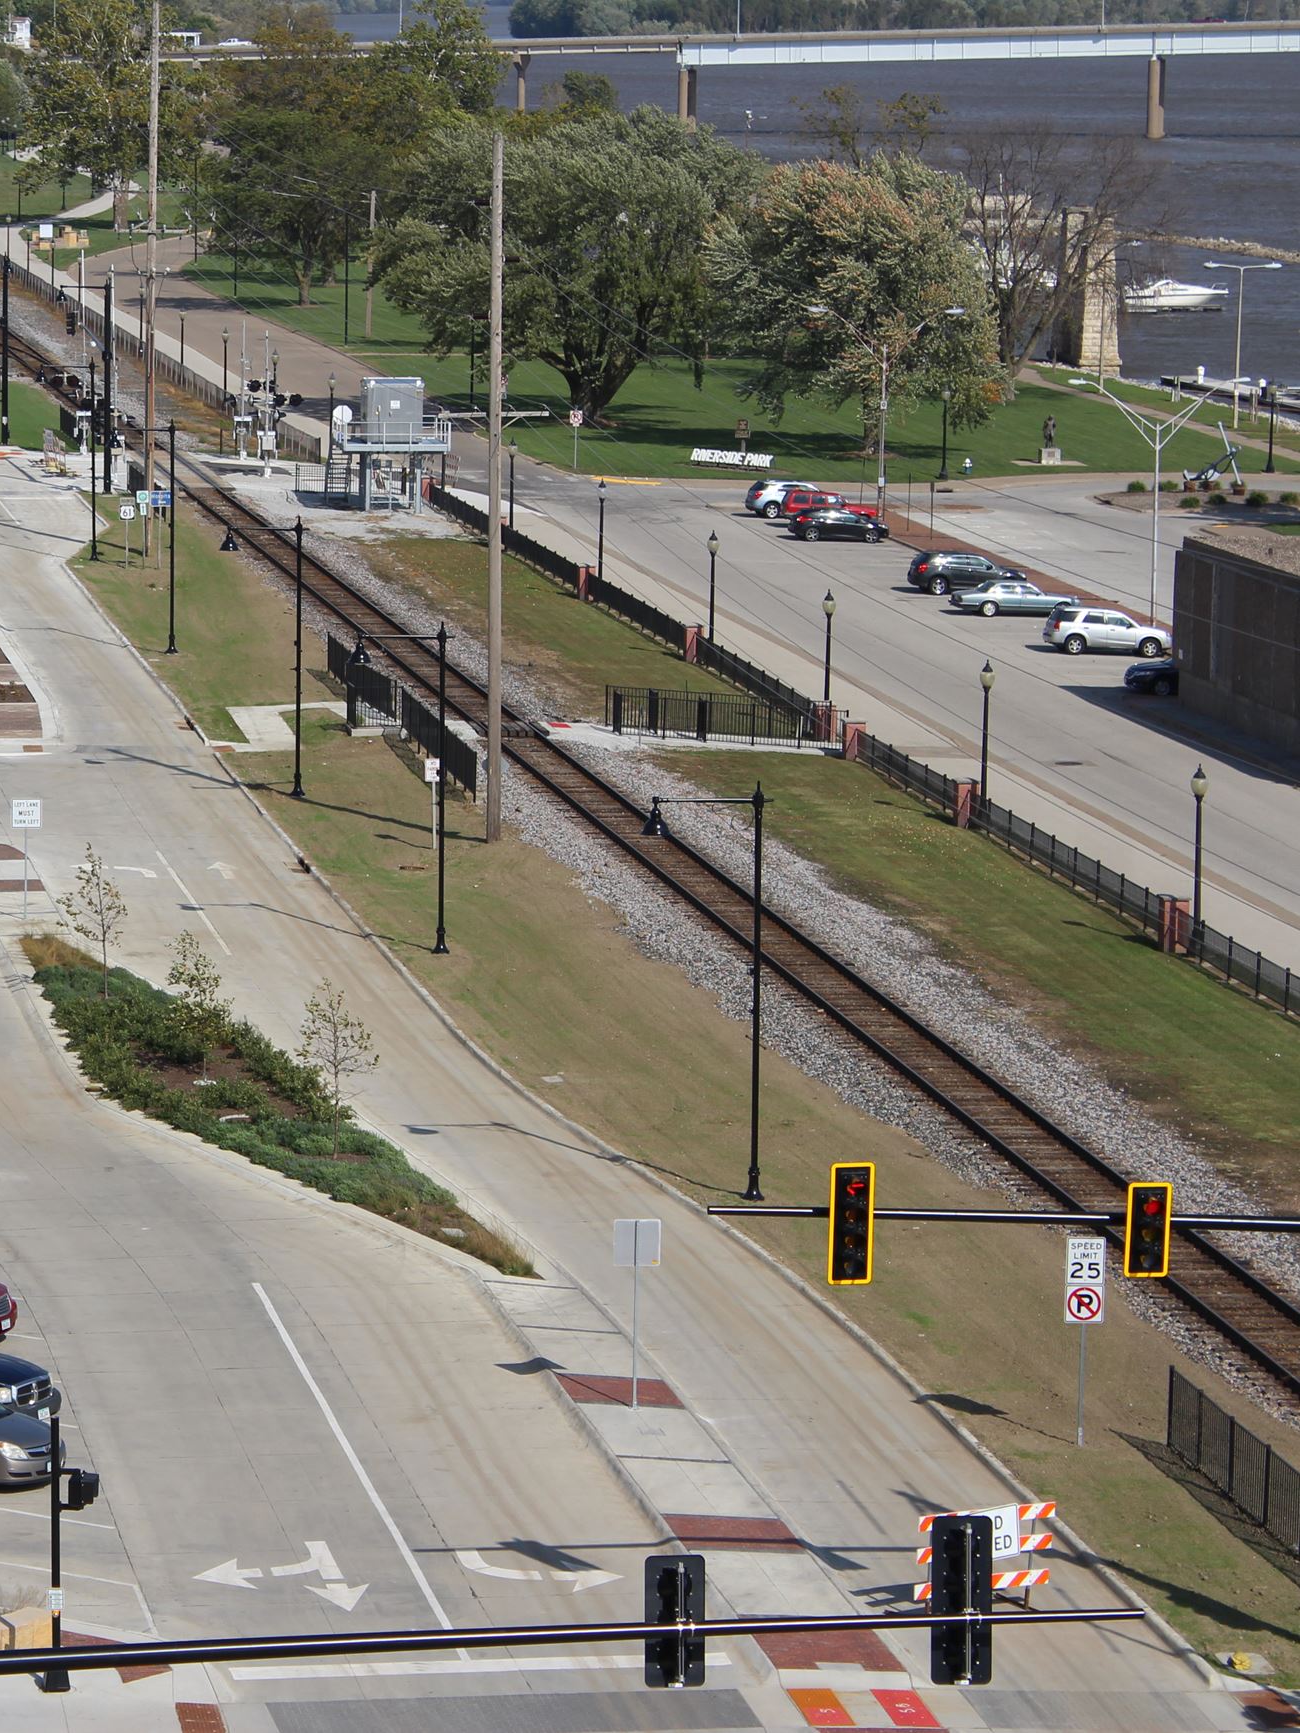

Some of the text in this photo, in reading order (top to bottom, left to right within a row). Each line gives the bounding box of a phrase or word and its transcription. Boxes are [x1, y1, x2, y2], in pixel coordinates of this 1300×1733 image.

[690, 447, 774, 468] RIVERSIDE PARK
[122, 508, 132, 517] 61
[1071, 1242, 1102, 1250] SPEED
[1073, 1252, 1098, 1260] LIMIT
[1070, 1262, 1100, 1279] 25
